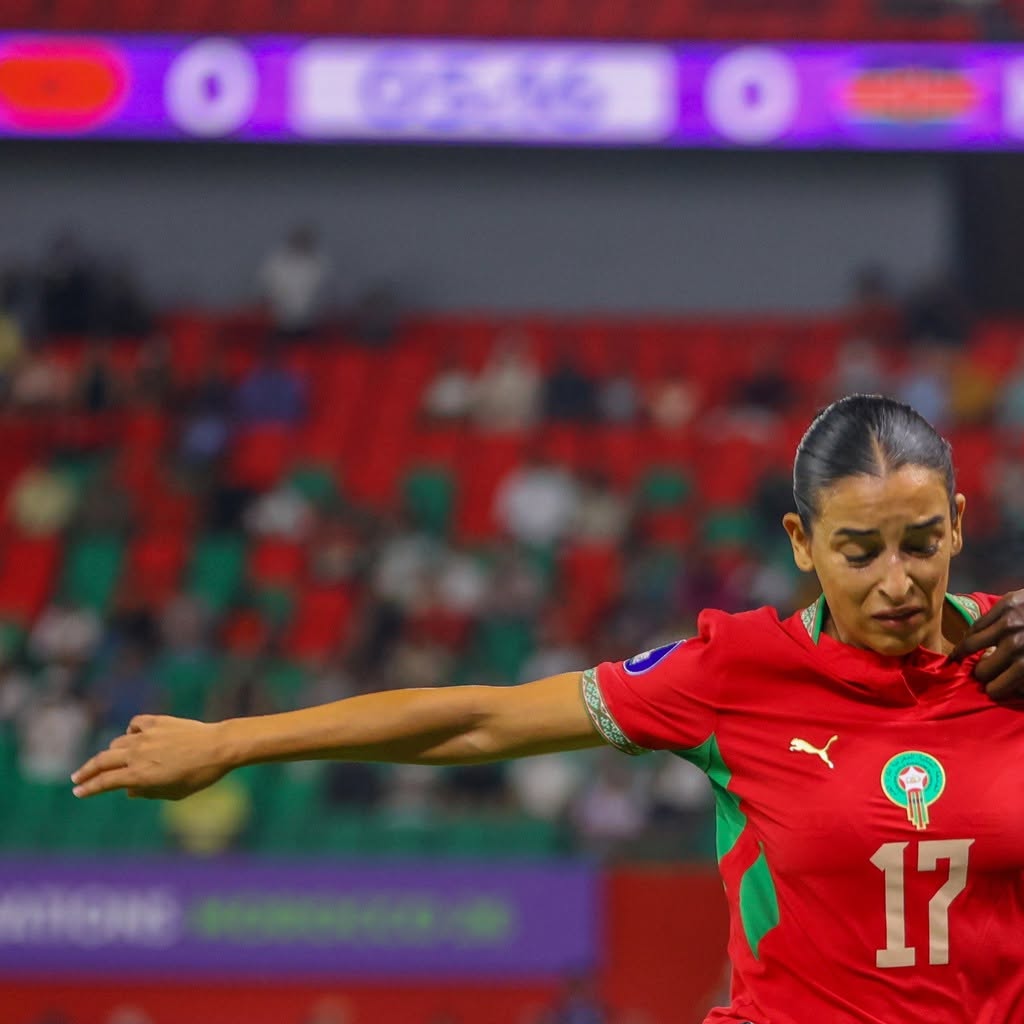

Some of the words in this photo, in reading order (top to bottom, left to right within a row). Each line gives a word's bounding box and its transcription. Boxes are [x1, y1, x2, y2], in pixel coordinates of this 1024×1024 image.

[166, 38, 257, 137] 0
[707, 46, 796, 144] 0
[869, 838, 976, 968] 17
